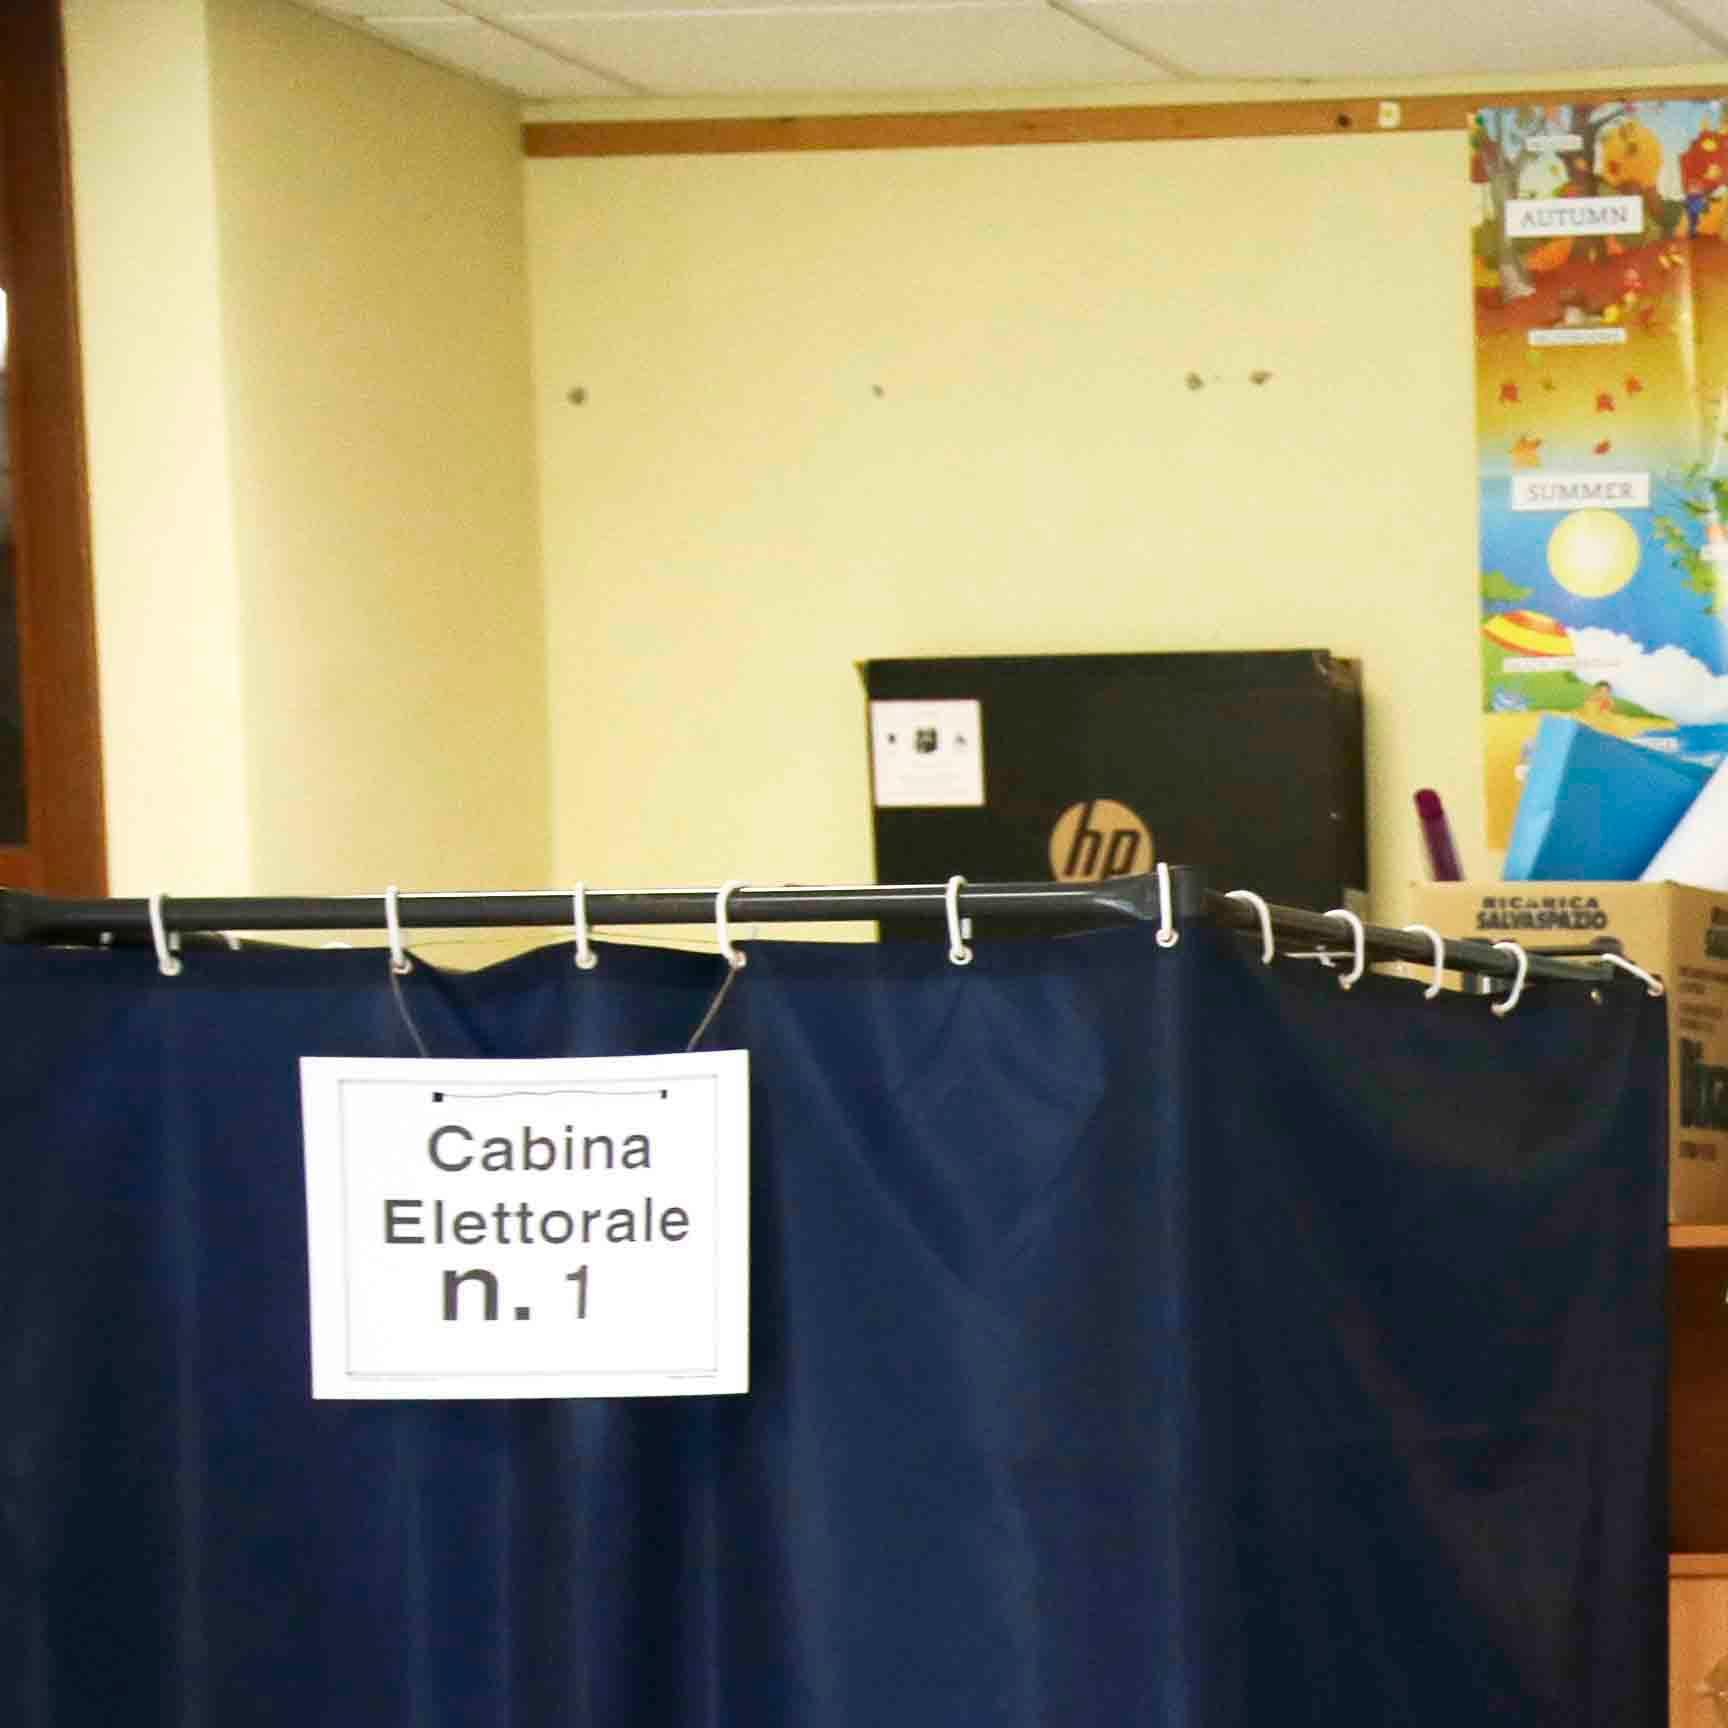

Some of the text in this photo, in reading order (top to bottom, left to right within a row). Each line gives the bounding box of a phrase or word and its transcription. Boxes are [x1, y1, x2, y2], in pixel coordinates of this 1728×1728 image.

[1520, 205, 1628, 228] AUTUMN
[1527, 481, 1633, 501] SUMMER
[1061, 801, 1142, 879] hp
[1475, 910, 1608, 931] SALVASPAZIO
[1482, 896, 1599, 910] RICARICA
[427, 1124, 652, 1172] Cabina
[383, 1196, 690, 1246] Elettorale
[441, 1264, 589, 1321] n. 1
